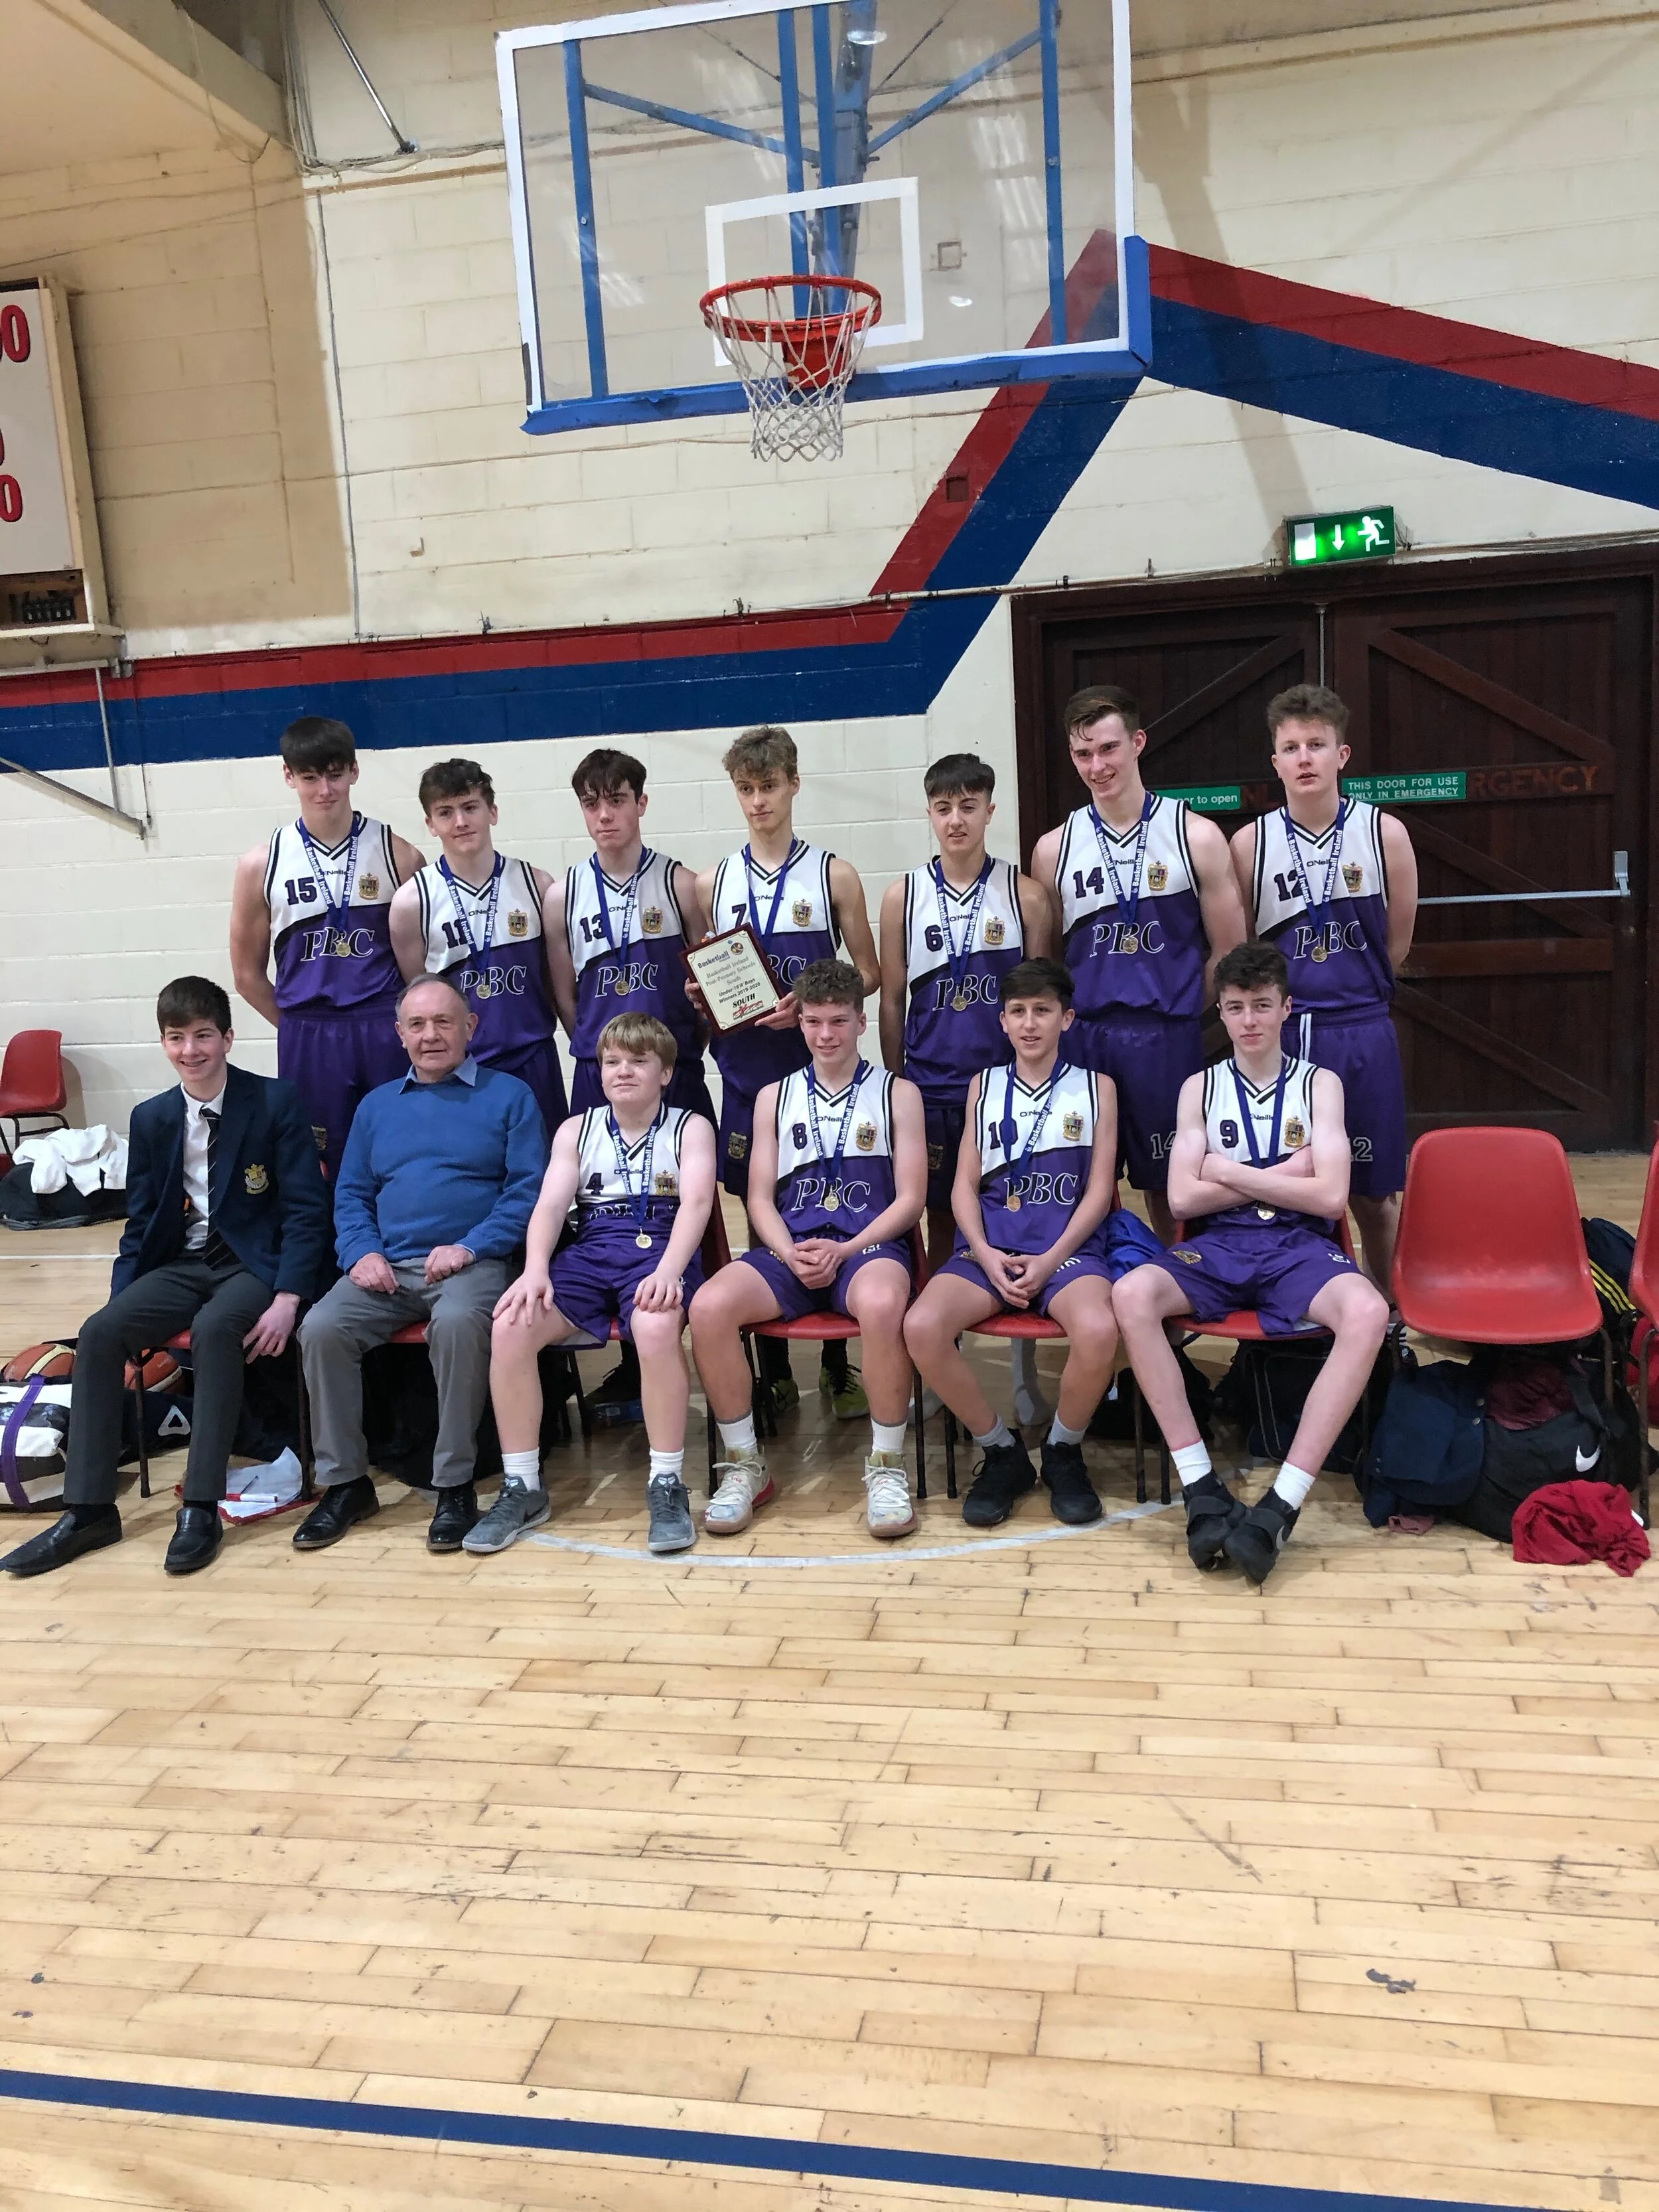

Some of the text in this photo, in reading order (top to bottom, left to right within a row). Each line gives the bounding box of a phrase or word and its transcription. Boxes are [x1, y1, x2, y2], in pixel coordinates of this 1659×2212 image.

[1348, 776, 1459, 790] THIS DOOR FOR USE
[1348, 792, 1373, 800] ONLY
[1394, 788, 1459, 798] EMERGENCY
[1467, 765, 1600, 798] RGENCY
[1196, 796, 1208, 804] to
[1210, 795, 1238, 805] open
[344, 836, 358, 896] Basketball Ireland
[1096, 833, 1123, 895] Basketball Ireland
[1132, 821, 1148, 887] Basketball Ireland
[1325, 830, 1343, 897] Basketball Ireland
[305, 847, 333, 905] Basketball Ireland
[1072, 867, 1105, 899] 14
[1273, 869, 1303, 902] 12
[1288, 839, 1313, 904] Basketball Ireland
[285, 876, 318, 906] 15
[486, 877, 500, 936] Basketball Ireland
[449, 885, 474, 945] Basketball Ireland
[579, 913, 607, 943] 13
[623, 897, 634, 932] Basketball
[731, 903, 747, 929] 7
[937, 893, 954, 955] Basketball Ireland
[965, 883, 985, 946] Basketball Ireland
[301, 926, 376, 962] PBC
[441, 919, 468, 949] 11
[924, 924, 944, 952] 6
[1090, 921, 1165, 958] PBC
[1293, 920, 1367, 960] PBC
[697, 950, 729, 969] Basketball
[706, 963, 732, 978] Basketball
[731, 955, 749, 967] Ireland
[737, 960, 757, 972] Schools
[460, 965, 528, 997] PBC
[595, 962, 658, 998] PBC
[719, 982, 761, 1004] Winners 2019-2020
[727, 976, 742, 985] South
[744, 977, 756, 986] Boys
[932, 974, 998, 1011] PBC
[733, 993, 756, 1008] SOUTH
[808, 1095, 824, 1156] Basketball Ireland
[838, 1083, 860, 1144] Basketball Ireland
[1027, 1109, 1048, 1147] Basketball
[792, 1122, 808, 1151] 8
[988, 1117, 1018, 1150] 10
[1150, 1131, 1177, 1159] 14
[1219, 1119, 1239, 1149] 9
[1350, 1136, 1373, 1162] 2
[613, 1135, 632, 1195] Basketball Ireland
[642, 1147, 653, 1187] Basketball
[585, 1172, 605, 1195] 4
[791, 1177, 871, 1213] PBC
[1003, 1172, 1078, 1209] PBC
